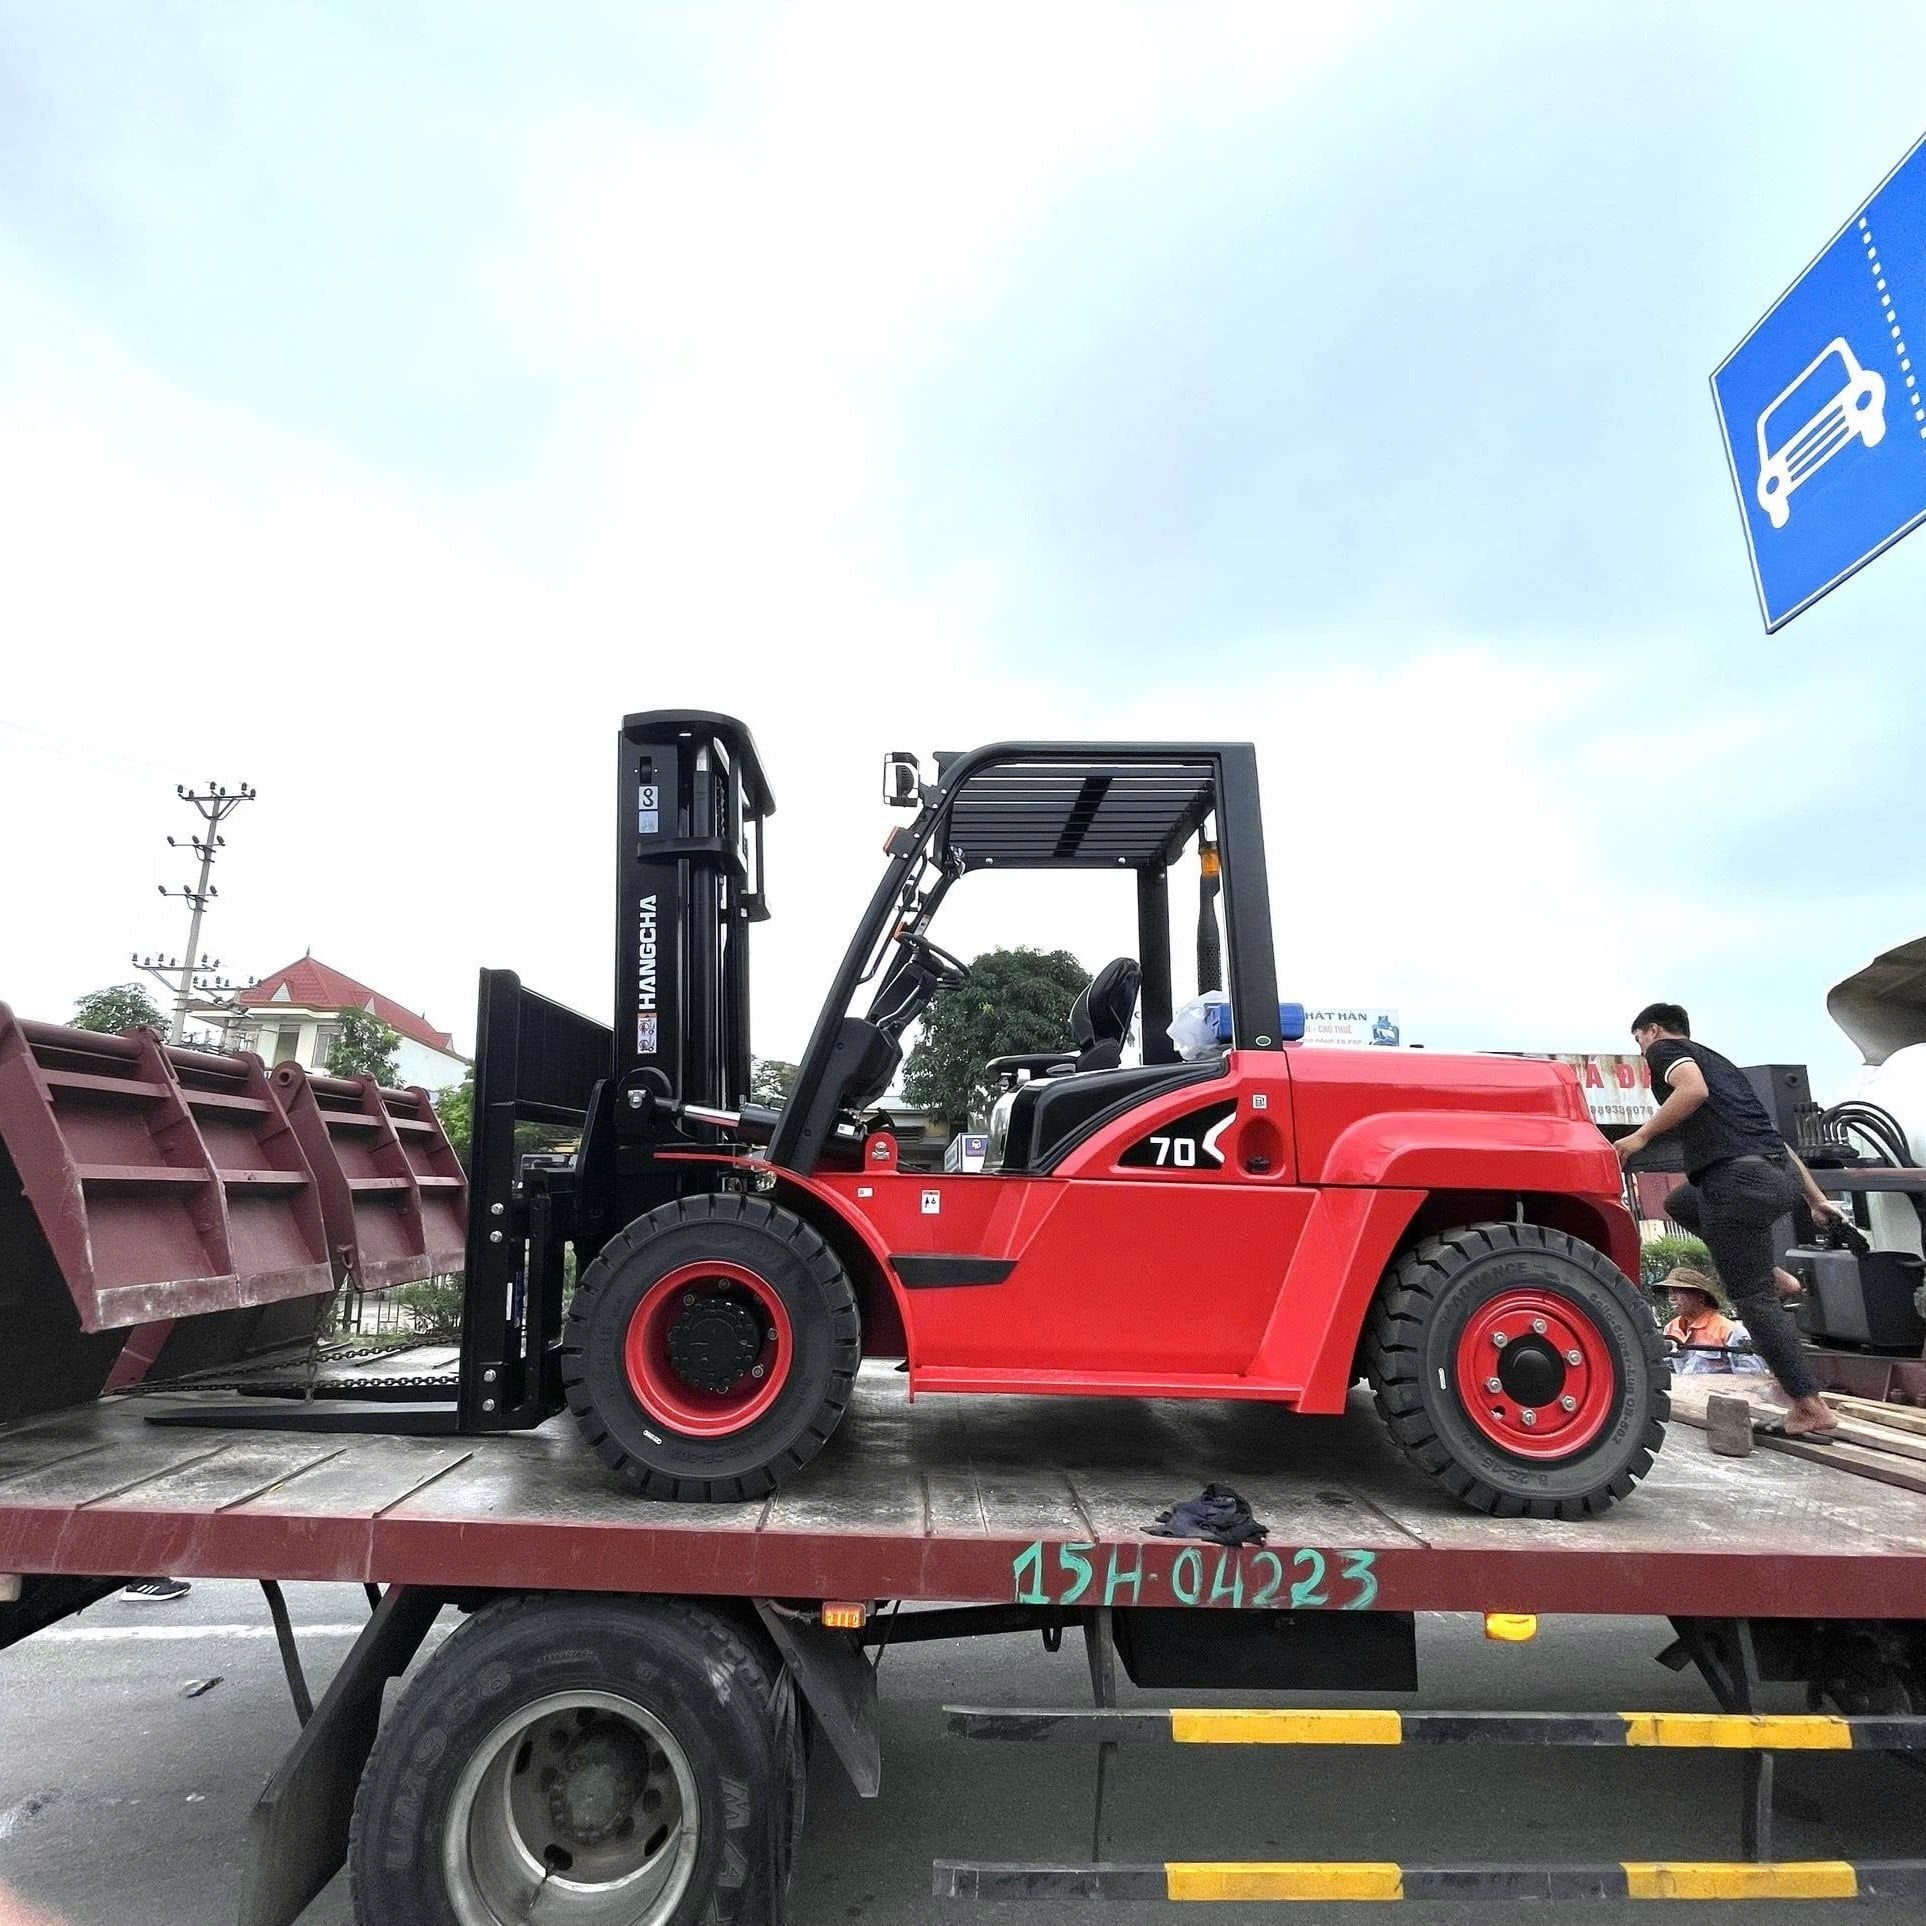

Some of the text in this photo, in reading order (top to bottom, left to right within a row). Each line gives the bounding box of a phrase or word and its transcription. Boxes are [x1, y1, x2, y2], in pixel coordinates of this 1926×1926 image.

[638, 894, 657, 1010] HANGCHA
[1149, 1136, 1196, 1167] 70
[1012, 1541, 1379, 1610] 15H-04223
